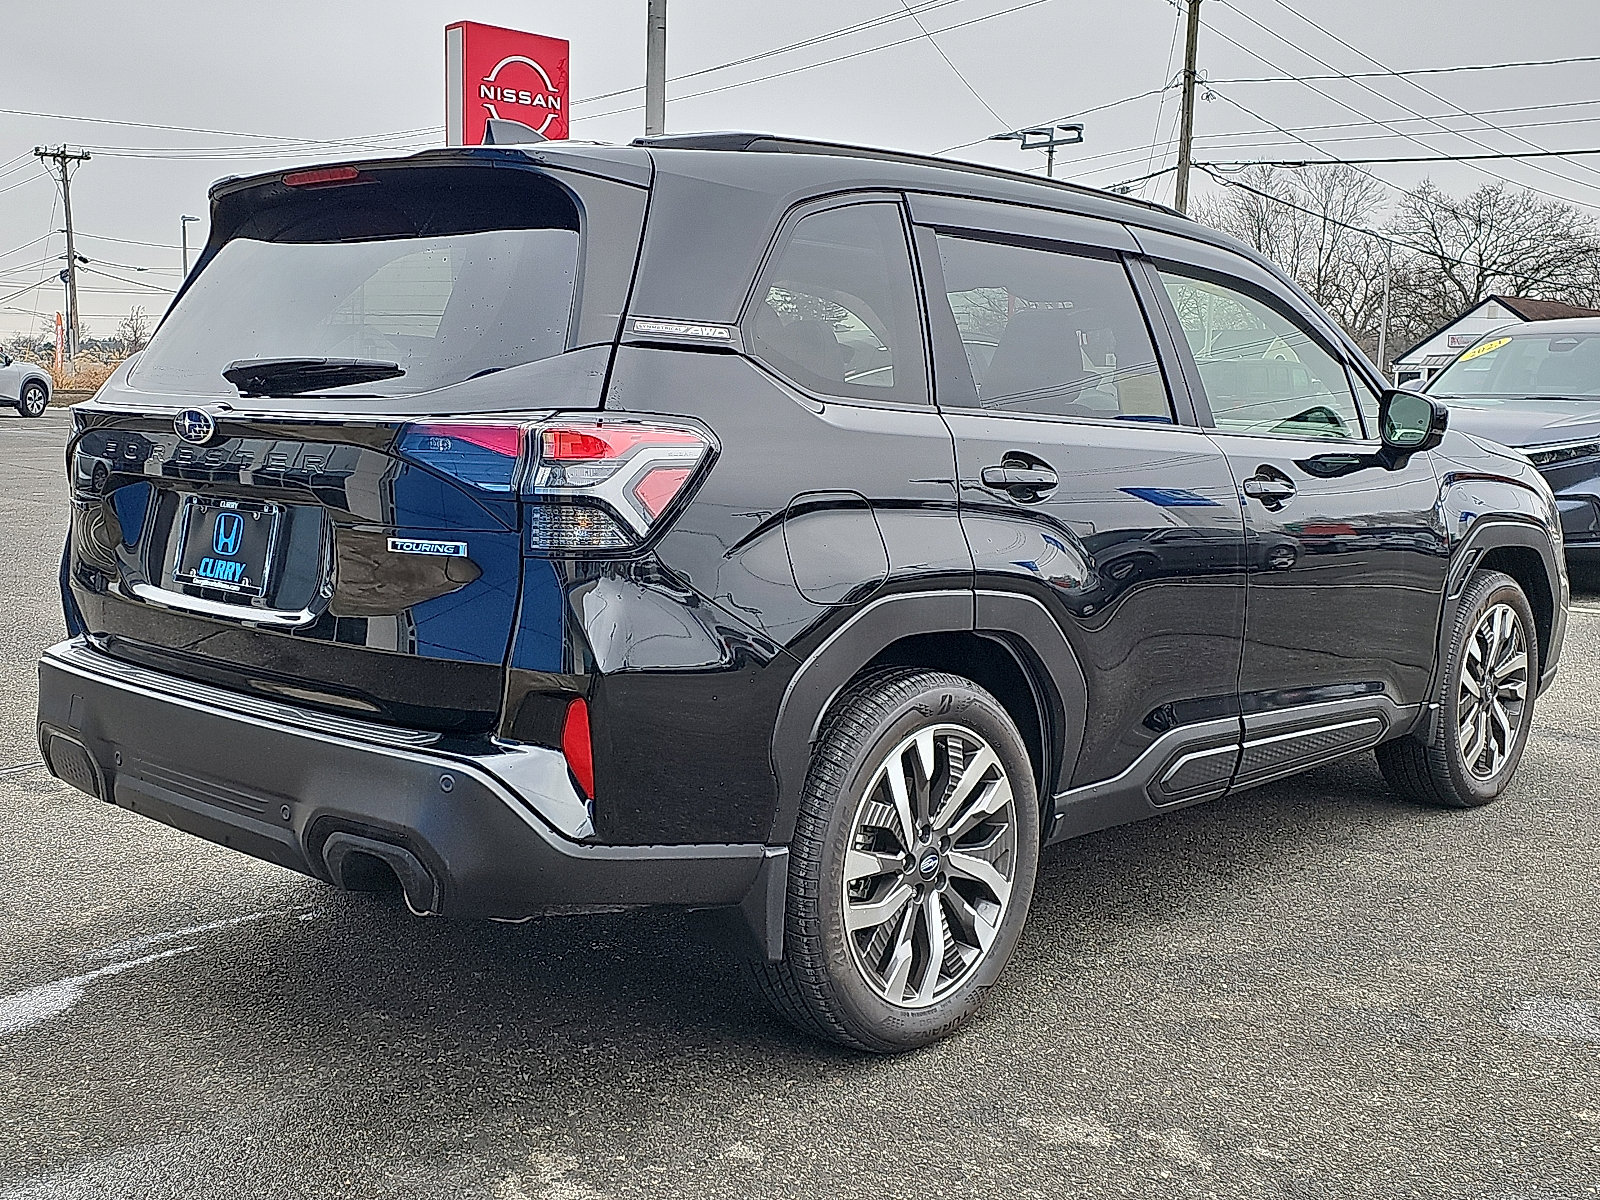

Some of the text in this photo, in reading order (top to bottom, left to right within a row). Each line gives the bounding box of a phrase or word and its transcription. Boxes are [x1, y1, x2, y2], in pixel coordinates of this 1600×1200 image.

[480, 84, 561, 110] NISSAN
[105, 441, 325, 474] FORESTER
[220, 501, 239, 509] CURRY
[395, 541, 456, 553] TOURING
[198, 557, 247, 582] CURRY
